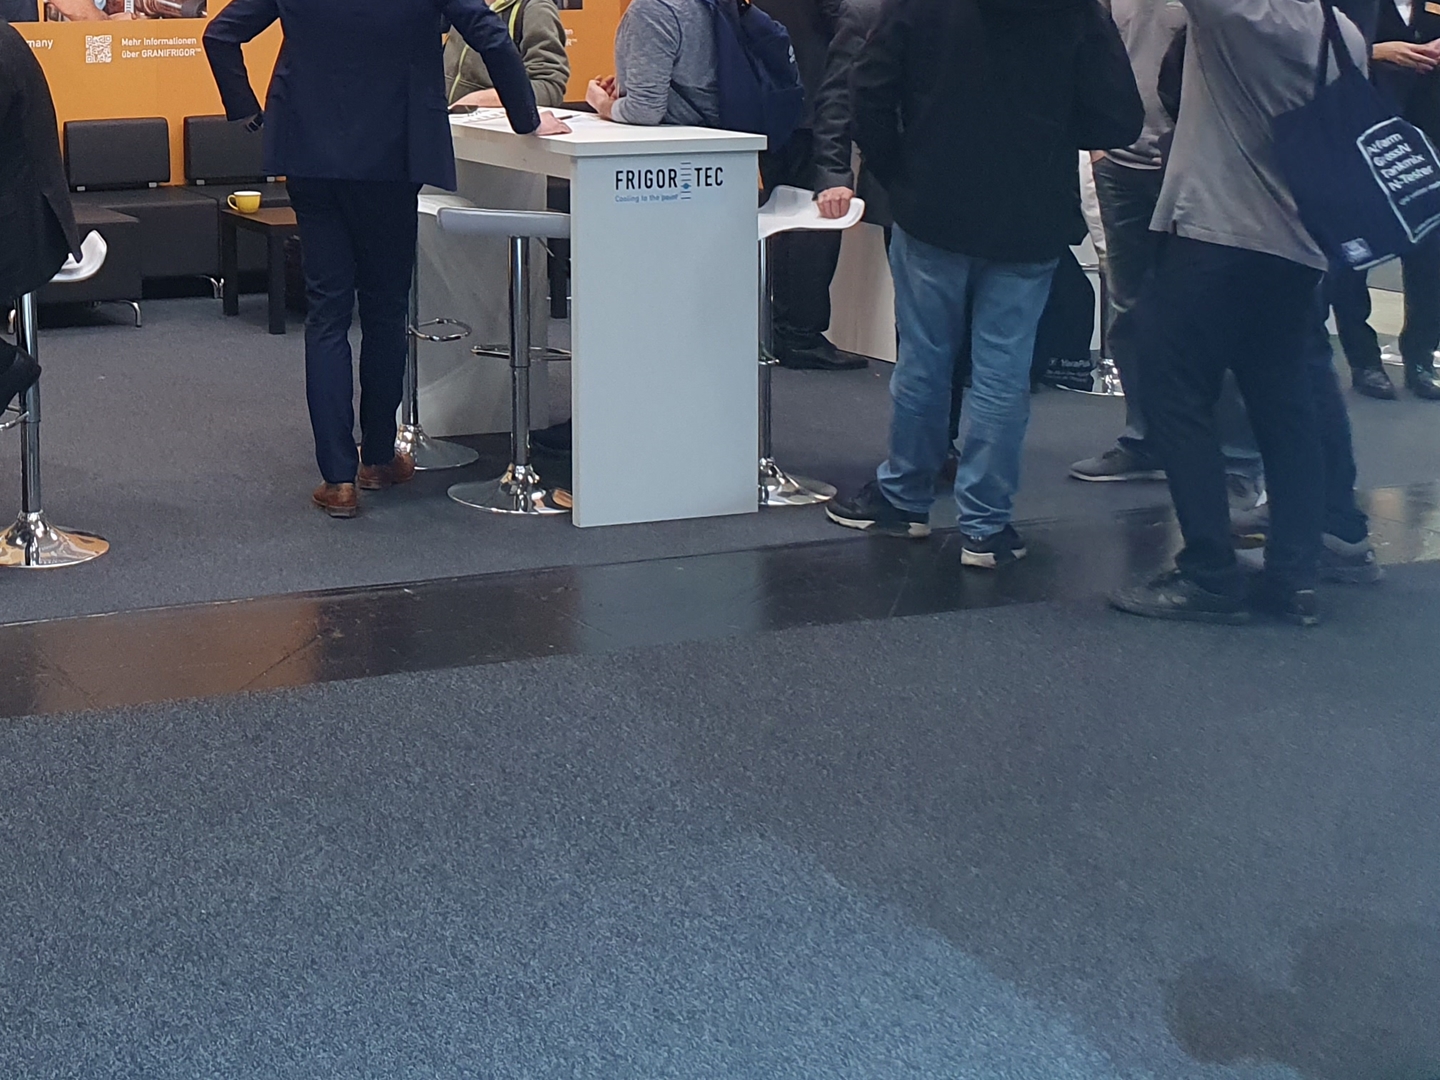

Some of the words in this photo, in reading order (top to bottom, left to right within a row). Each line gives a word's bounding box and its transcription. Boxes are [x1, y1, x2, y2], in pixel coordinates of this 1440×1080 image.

[121, 38, 141, 46] Mehr
[143, 36, 197, 46] Informationen
[121, 50, 140, 58] über
[615, 194, 639, 203] Cooling
